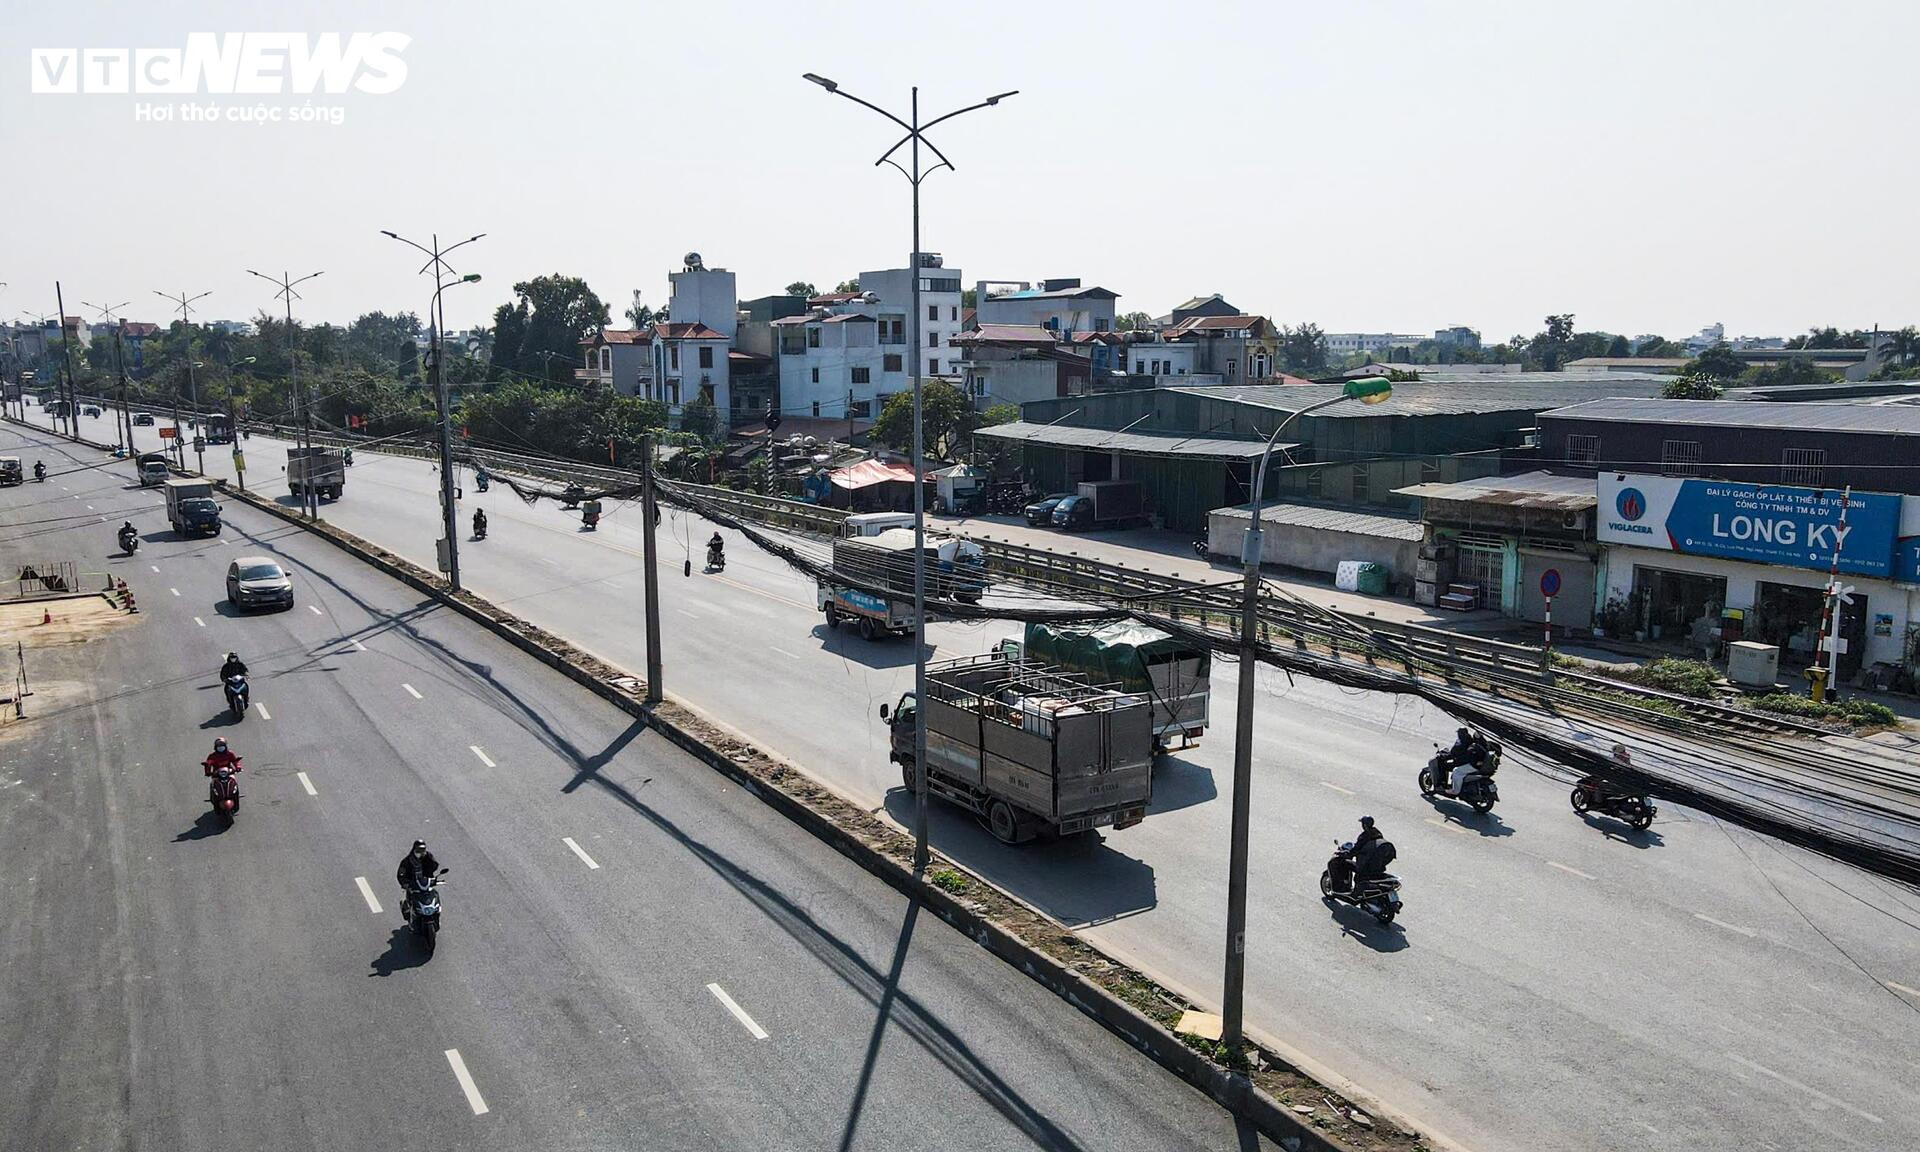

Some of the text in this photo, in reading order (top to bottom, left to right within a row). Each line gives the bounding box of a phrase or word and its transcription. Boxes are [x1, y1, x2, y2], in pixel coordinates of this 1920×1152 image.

[1735, 500, 1758, 509] CÔNG
[1772, 504, 1793, 512] TNHH
[1797, 506, 1808, 514] TM
[1809, 507, 1815, 515] &
[1818, 508, 1829, 516] DV
[1608, 522, 1653, 534] VIGLACERA
[1713, 513, 1796, 545] LONG
